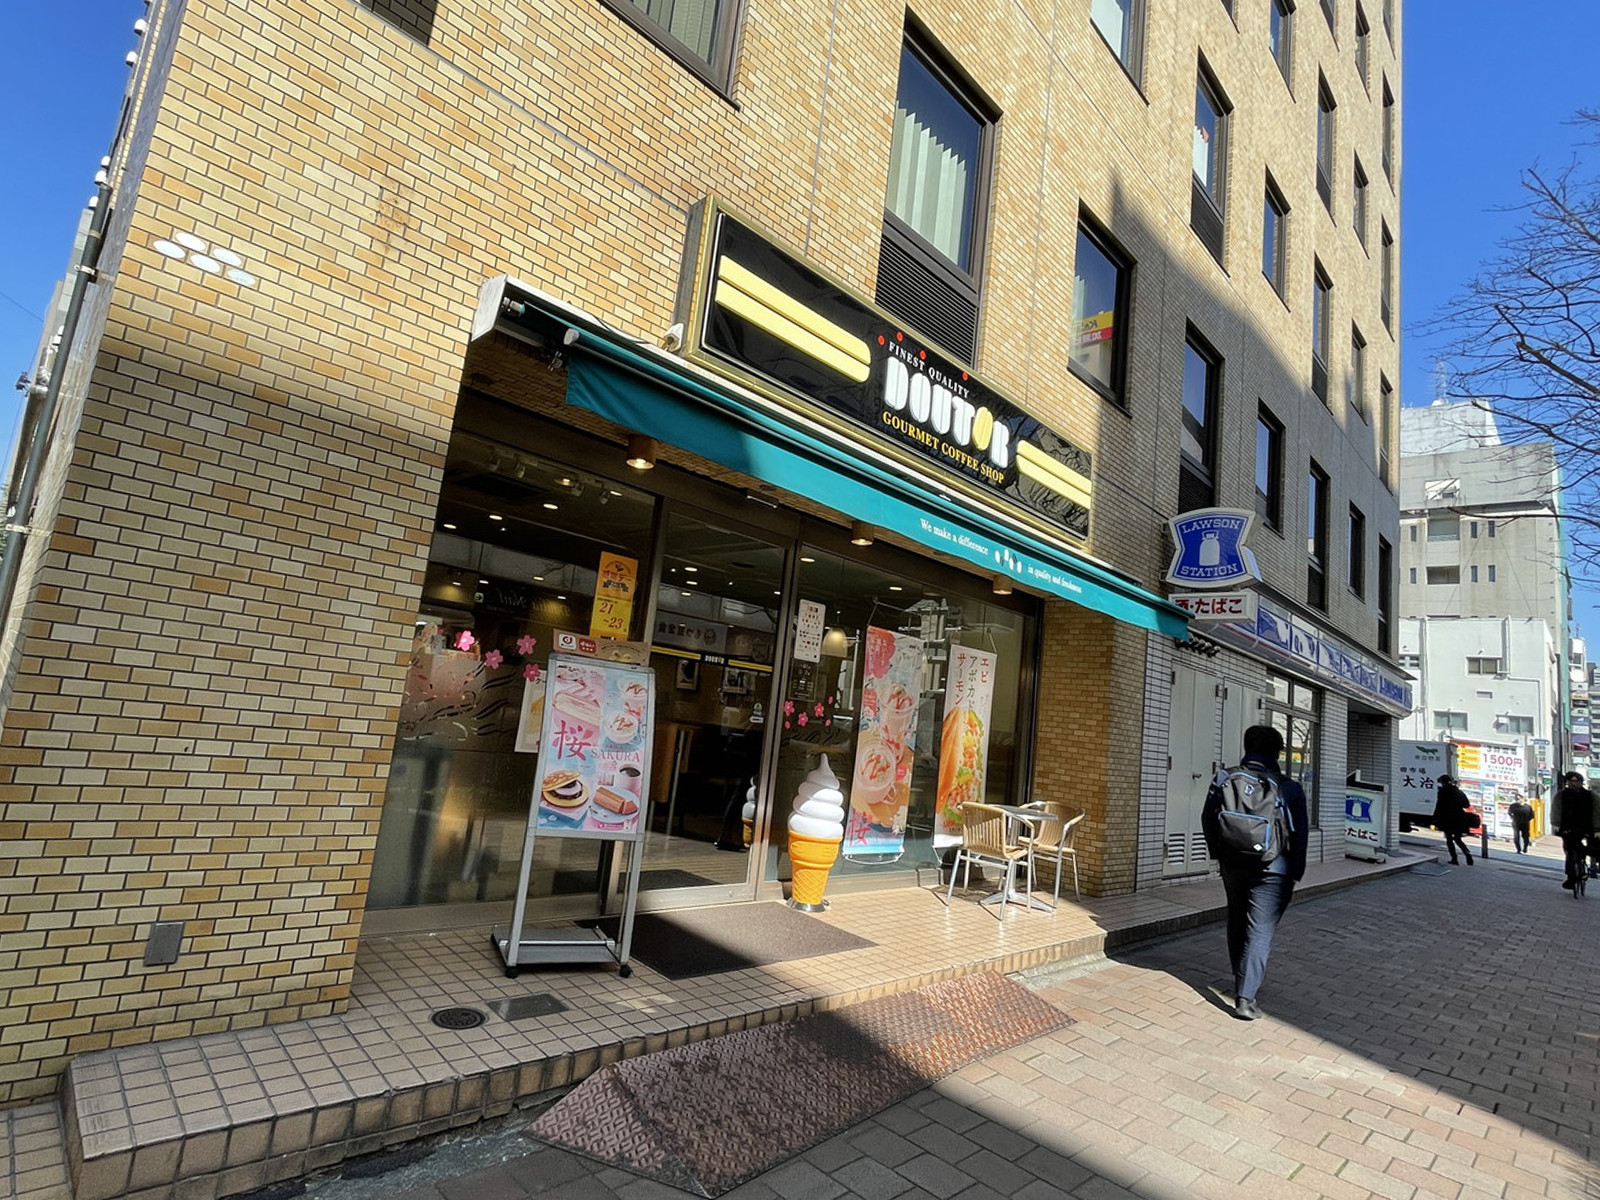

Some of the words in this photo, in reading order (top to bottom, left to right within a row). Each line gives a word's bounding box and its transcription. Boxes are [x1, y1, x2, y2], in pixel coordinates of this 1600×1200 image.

[888, 341, 925, 372] FINEST
[928, 366, 970, 399] QUALITY
[884, 356, 1010, 469] DOUTOR
[882, 411, 939, 451] GOURMET
[941, 442, 979, 471] COFFEE
[979, 462, 1005, 484] SHOP
[920, 518, 932, 533] We
[933, 526, 952, 540] make
[952, 534, 958, 543] a
[1182, 518, 1240, 534] LAWSON
[1180, 563, 1239, 577] STATION
[956, 653, 967, 705] サーモン
[980, 658, 989, 683] エビ
[552, 719, 591, 761] 桜
[590, 748, 640, 763] SAKURA
[1483, 754, 1523, 768] 1500円
[1403, 775, 1435, 790] 大治
[846, 807, 872, 848] 桜
